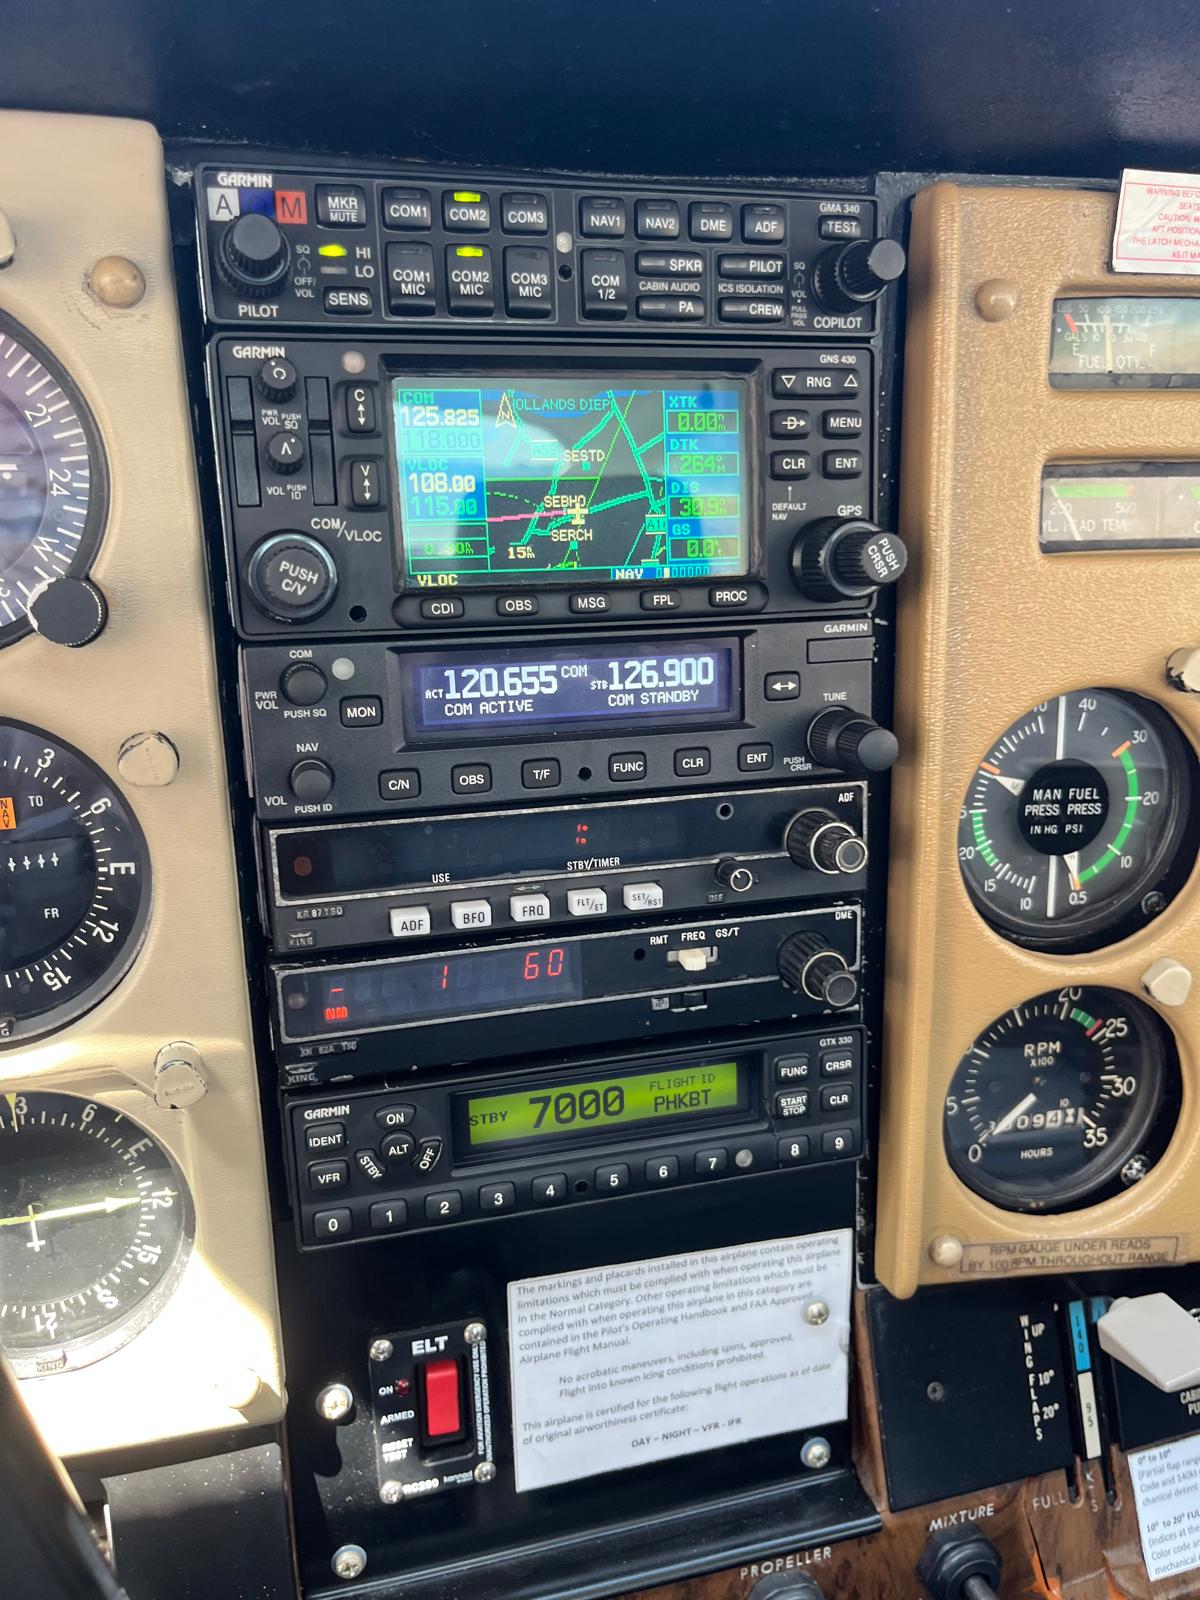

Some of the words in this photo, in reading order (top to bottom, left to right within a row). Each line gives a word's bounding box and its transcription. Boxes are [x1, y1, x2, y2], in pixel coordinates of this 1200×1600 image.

[217, 174, 273, 188] GARMIN
[328, 197, 358, 209] MKR
[820, 204, 842, 213] GMA
[844, 205, 860, 214] 340
[330, 213, 358, 222] MUTE
[391, 206, 428, 218] COM1
[450, 209, 487, 221] COM2
[509, 212, 544, 223] COM3
[591, 216, 621, 227] NAV1
[646, 218, 675, 230] NAV2
[701, 220, 726, 232] DME
[755, 222, 777, 233] ADF
[827, 222, 857, 233] TEST
[356, 248, 371, 259] HI
[669, 260, 702, 271] SPKR
[750, 261, 782, 273] PILOT
[355, 266, 374, 278] LO
[394, 270, 430, 282] COM1
[452, 271, 489, 283] COM2
[512, 273, 547, 285] COM3
[592, 276, 620, 287] COM
[401, 284, 426, 295] MIC
[460, 283, 484, 295] MIC
[519, 286, 542, 298] MIC
[639, 282, 668, 291] CABIN
[670, 282, 700, 292] AUDIO
[719, 284, 734, 293] ICS
[736, 284, 783, 294] ISOLATION
[329, 294, 368, 306] SENS
[239, 305, 278, 318] PILOT
[679, 302, 693, 313] PA
[750, 304, 782, 316] CREW
[814, 317, 862, 329] COPILOT
[233, 346, 285, 359] GARMIN
[820, 355, 838, 363] GNS
[806, 377, 831, 388] RNG
[25, 404, 51, 428] 21
[400, 407, 480, 426] 125.825
[830, 418, 862, 428] MENU
[670, 439, 698, 450] DTK
[783, 459, 805, 469] CLR
[836, 458, 857, 468] ENT
[50, 469, 70, 496] 24
[409, 473, 476, 493] 108.00
[411, 496, 477, 516] 115.00
[837, 506, 862, 516] GPS
[879, 538, 899, 570] PUSH
[868, 545, 888, 578] CRSR
[280, 561, 318, 585] PUSH
[615, 569, 643, 579] NAV
[417, 574, 458, 586] VLOC
[653, 595, 674, 606] FPL
[716, 591, 747, 602] PROC
[431, 603, 454, 614] CDI
[506, 600, 532, 612] OBS
[578, 597, 605, 609] MSG
[824, 624, 868, 633] GARMIN
[290, 650, 312, 658] COM
[608, 657, 714, 690] 126.900
[425, 690, 443, 699] ACT
[443, 665, 558, 699] 120.655
[608, 694, 634, 706] COM
[641, 690, 699, 704] STANDBY
[823, 692, 847, 701] TUNE
[445, 703, 472, 716] COM
[480, 700, 534, 714] ACTIVE
[1079, 699, 1096, 710] 40
[284, 710, 310, 719] PUSH
[347, 707, 376, 718] MON
[1132, 731, 1147, 743] 30
[296, 743, 319, 752] NAV
[682, 758, 704, 768] CLR
[747, 753, 767, 764] ENT
[784, 757, 805, 765] PUSH
[613, 762, 643, 772] FUNC
[790, 762, 812, 771] CRSR
[459, 774, 484, 785] OBS
[533, 769, 550, 780] T/F
[388, 779, 410, 790] C/N
[838, 792, 854, 802] ADF
[1033, 789, 1061, 799] MAN
[1069, 788, 1100, 799] FUEL
[29, 795, 43, 807] TO
[1025, 804, 1059, 815] PRESS
[1067, 804, 1102, 814] PRESS
[1065, 825, 1082, 833] PSI
[567, 857, 620, 870] STBY/TIMER
[432, 873, 450, 883] USE
[44, 908, 59, 918] FR
[522, 905, 544, 917] FRQ
[835, 911, 852, 919] DME
[463, 912, 485, 924] BFO
[401, 920, 424, 932] ADF
[650, 935, 668, 945] RMT
[681, 930, 706, 941] FREQ
[715, 927, 739, 938] GS/T
[43, 967, 71, 991] 15
[1106, 1019, 1127, 1037] 25
[820, 1038, 835, 1047] GTX
[836, 1036, 852, 1045] 330
[1024, 1041, 1061, 1057] RPM
[826, 1060, 851, 1070] CRSR
[781, 1066, 807, 1077] FUNC
[650, 1076, 696, 1091] FLIGHT
[702, 1073, 715, 1084] ID
[1112, 1077, 1136, 1095] 30
[654, 1089, 711, 1112] PHKBT
[781, 1096, 807, 1106] START
[830, 1095, 848, 1104] CLR
[304, 1105, 350, 1119] GARMIN
[470, 1111, 508, 1126] STBY
[529, 1086, 624, 1128] 7000
[783, 1106, 805, 1116] STOP
[386, 1113, 404, 1124] ON
[309, 1134, 342, 1147] IDENT
[1083, 1129, 1107, 1147] 35
[388, 1144, 408, 1156] ALT
[1021, 1148, 1053, 1159] HOURS
[420, 1148, 435, 1170] OFF
[360, 1156, 383, 1180] STBY
[318, 1172, 340, 1184] VFR
[1065, 1242, 1106, 1251] UNDER
[1112, 1240, 1150, 1250] READS
[538, 1278, 582, 1292] markings
[606, 1267, 645, 1282] placards
[648, 1259, 687, 1273] installed
[720, 1249, 757, 1262] airplane
[796, 1236, 838, 1252] operating
[517, 1294, 569, 1309] limitations
[644, 1274, 687, 1290] complied
[550, 1306, 585, 1318] Normal
[520, 1336, 568, 1351] contained
[682, 1306, 728, 1321] Handbook
[1032, 1323, 1045, 1337] UP
[412, 1336, 448, 1355] ELT
[520, 1351, 561, 1364] Airplane
[564, 1344, 590, 1357] Flight
[379, 1386, 393, 1396] ON
[596, 1402, 634, 1417] certified
[380, 1410, 414, 1425] ARMED
[536, 1430, 572, 1443] original
[632, 1438, 650, 1448] DAY
[1033, 1492, 1065, 1511] FULL
[929, 1504, 994, 1531] MIXTURE
[740, 1547, 831, 1580] PROPELLER
